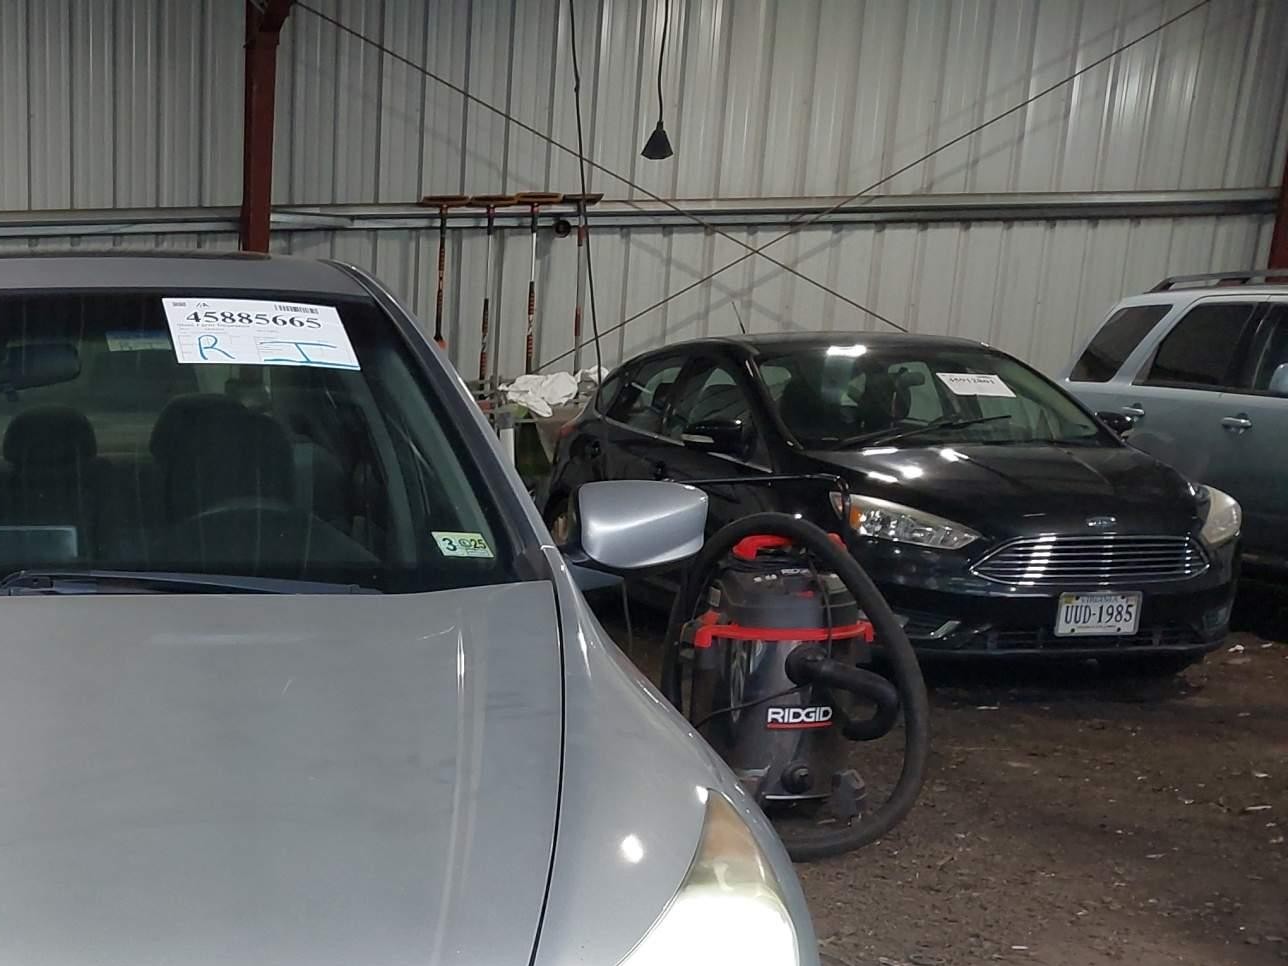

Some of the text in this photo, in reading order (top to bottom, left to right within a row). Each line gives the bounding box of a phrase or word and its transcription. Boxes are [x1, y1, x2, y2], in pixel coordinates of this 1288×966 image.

[186, 311, 322, 329] 45885665
[198, 334, 236, 360] R
[442, 537, 457, 552] 3
[470, 538, 487, 549] 25
[1064, 603, 1134, 624] UUD-1985
[767, 706, 832, 723] RIDGID
